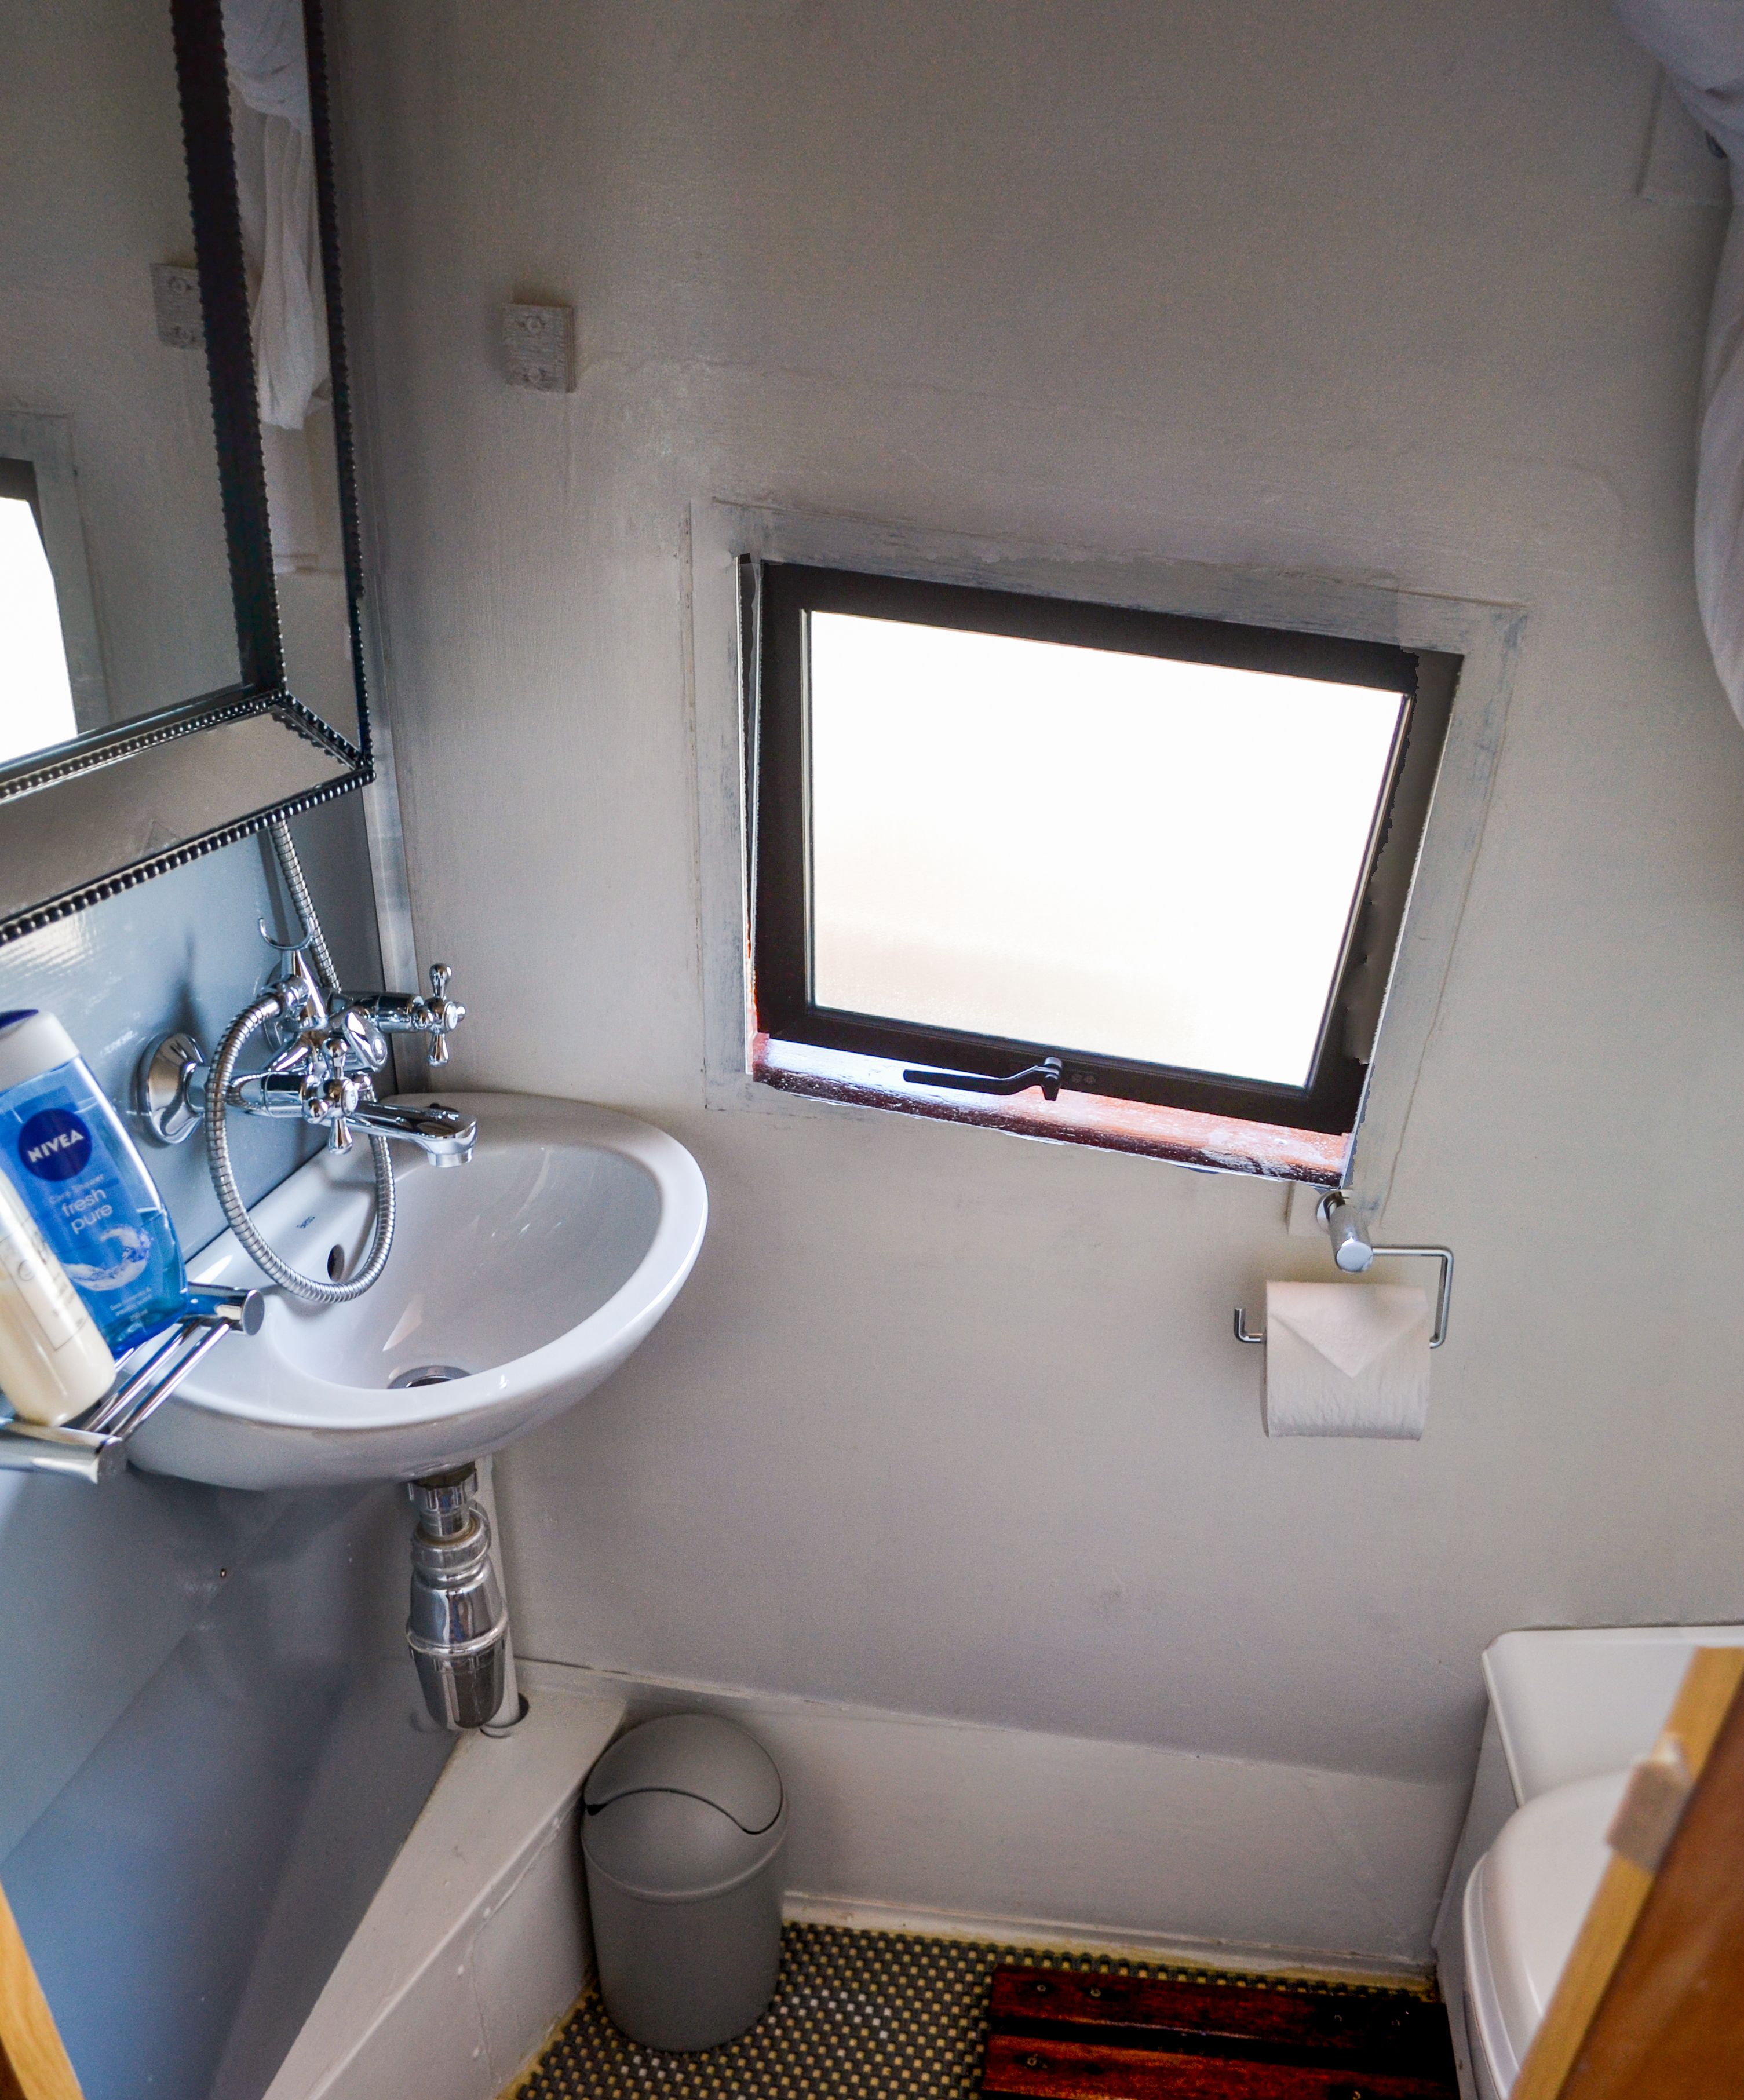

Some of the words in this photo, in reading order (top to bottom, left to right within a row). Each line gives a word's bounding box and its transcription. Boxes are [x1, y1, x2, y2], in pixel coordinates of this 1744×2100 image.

[27, 1129, 84, 1163] NIVEA
[62, 1189, 107, 1217] fresh
[71, 1204, 114, 1235] pure
